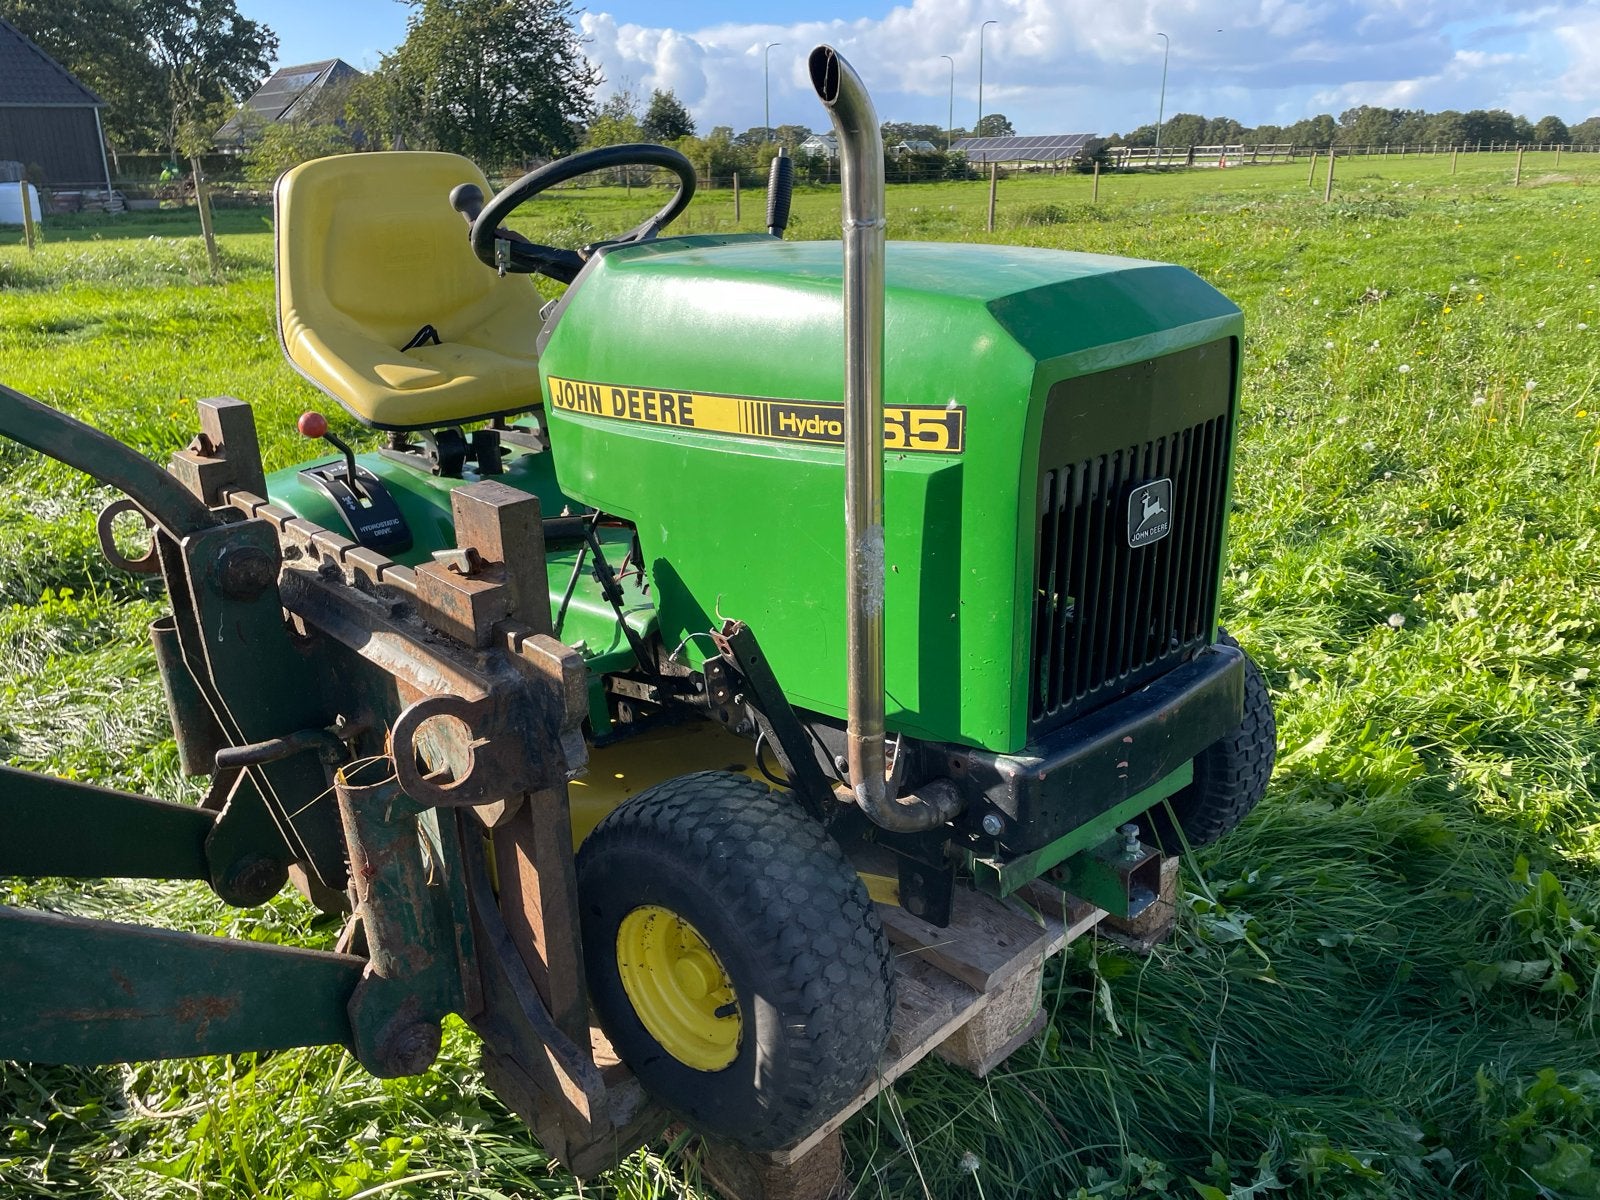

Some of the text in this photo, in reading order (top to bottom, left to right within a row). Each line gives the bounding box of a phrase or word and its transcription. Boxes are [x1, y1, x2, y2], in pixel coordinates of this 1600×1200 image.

[556, 380, 695, 426] JOHN DEERE
[779, 411, 842, 437] Hydro
[360, 518, 399, 532] HYDROSTATIC
[1131, 522, 1168, 541] JOHN DEERE
